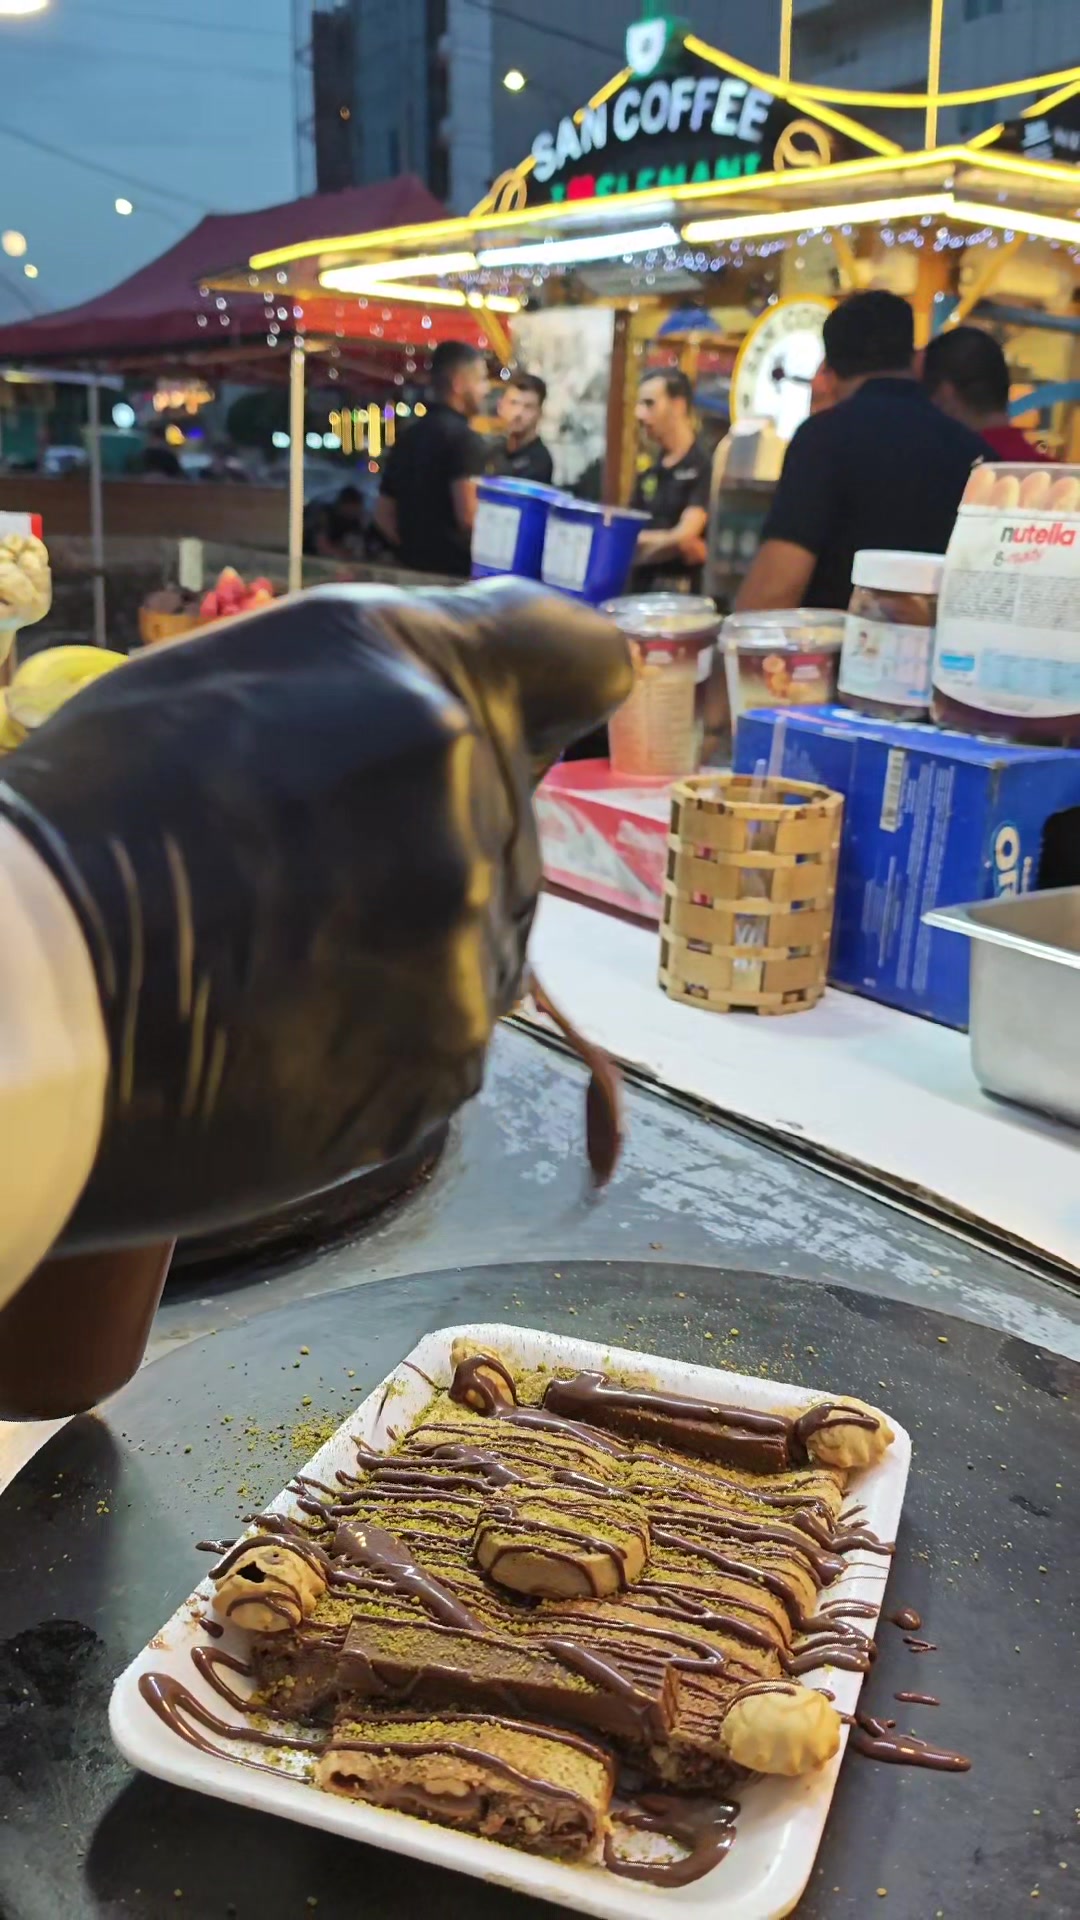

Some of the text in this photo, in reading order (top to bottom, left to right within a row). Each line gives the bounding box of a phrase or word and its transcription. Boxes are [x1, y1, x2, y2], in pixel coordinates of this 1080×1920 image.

[531, 76, 774, 183] SAN COFFEE
[1000, 521, 1076, 548] nutella
